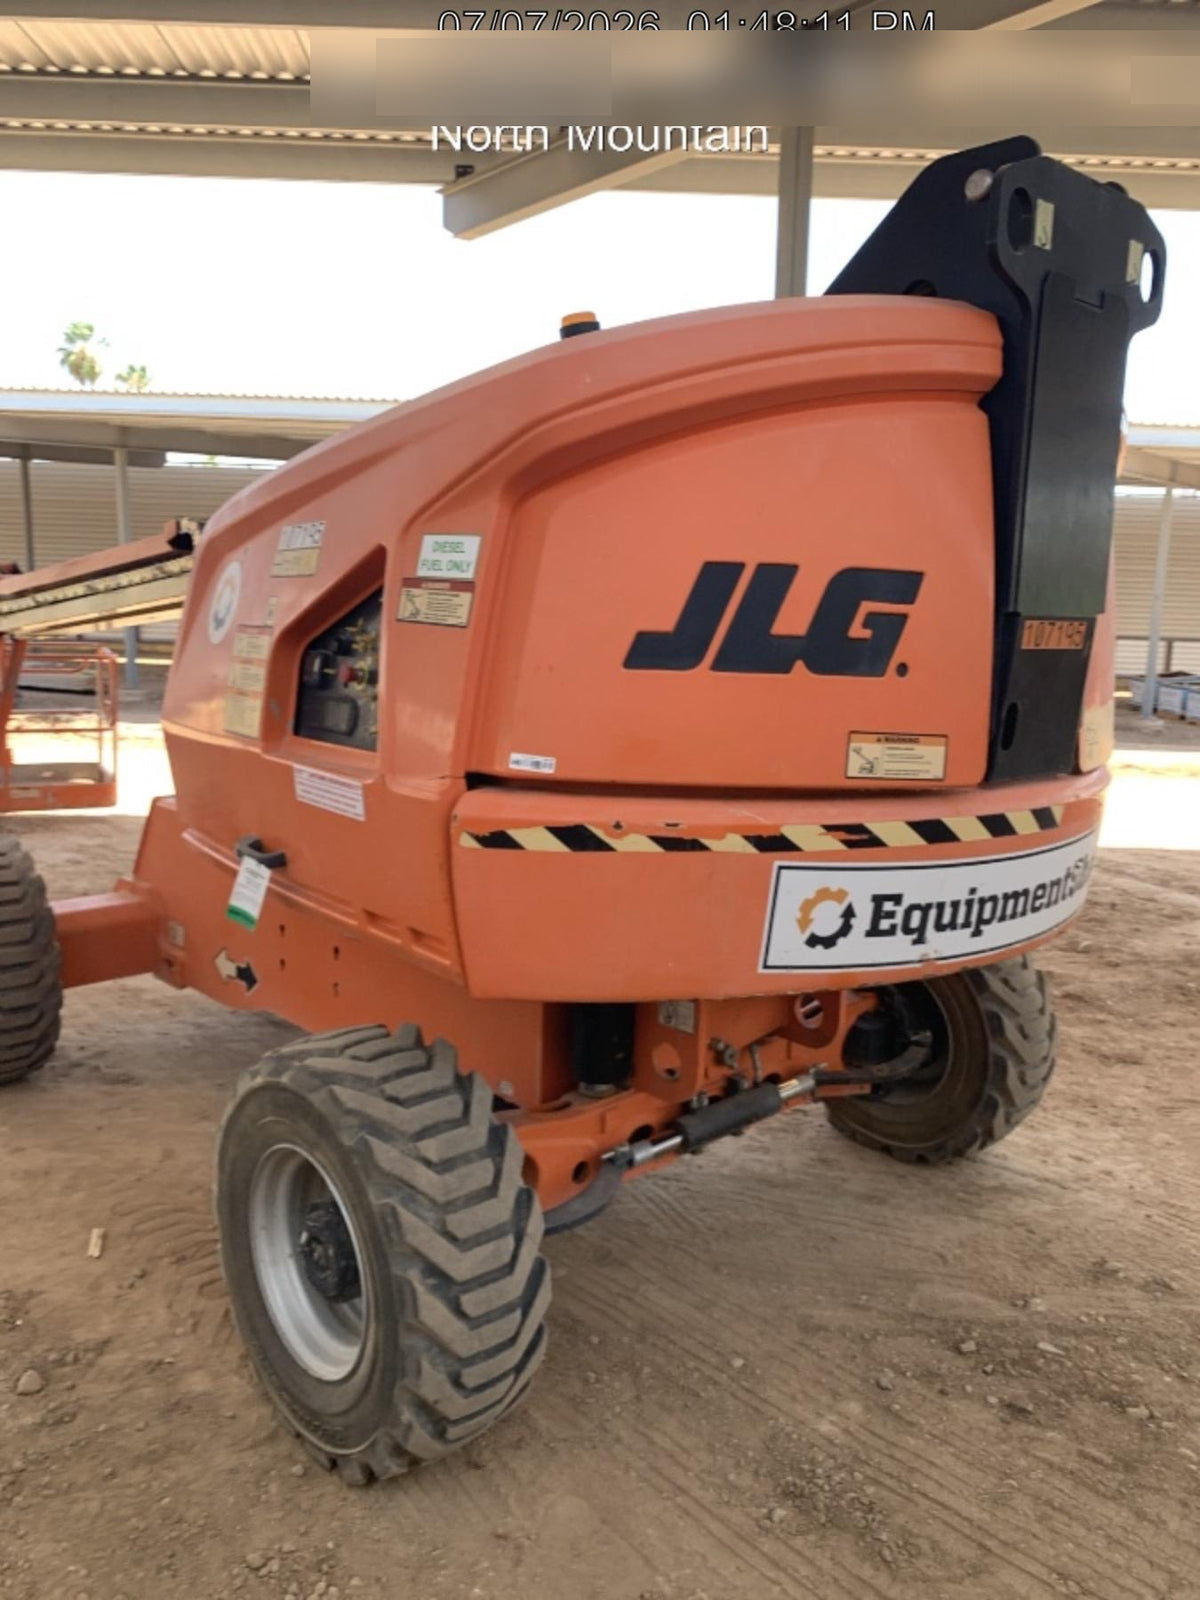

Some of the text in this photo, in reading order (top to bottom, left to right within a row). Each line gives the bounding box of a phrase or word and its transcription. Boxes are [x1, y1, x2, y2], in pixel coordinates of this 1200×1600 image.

[432, 540, 466, 553] DIESEL
[420, 558, 472, 573] FUEL ONLY
[865, 852, 1093, 945] EquipmentS
